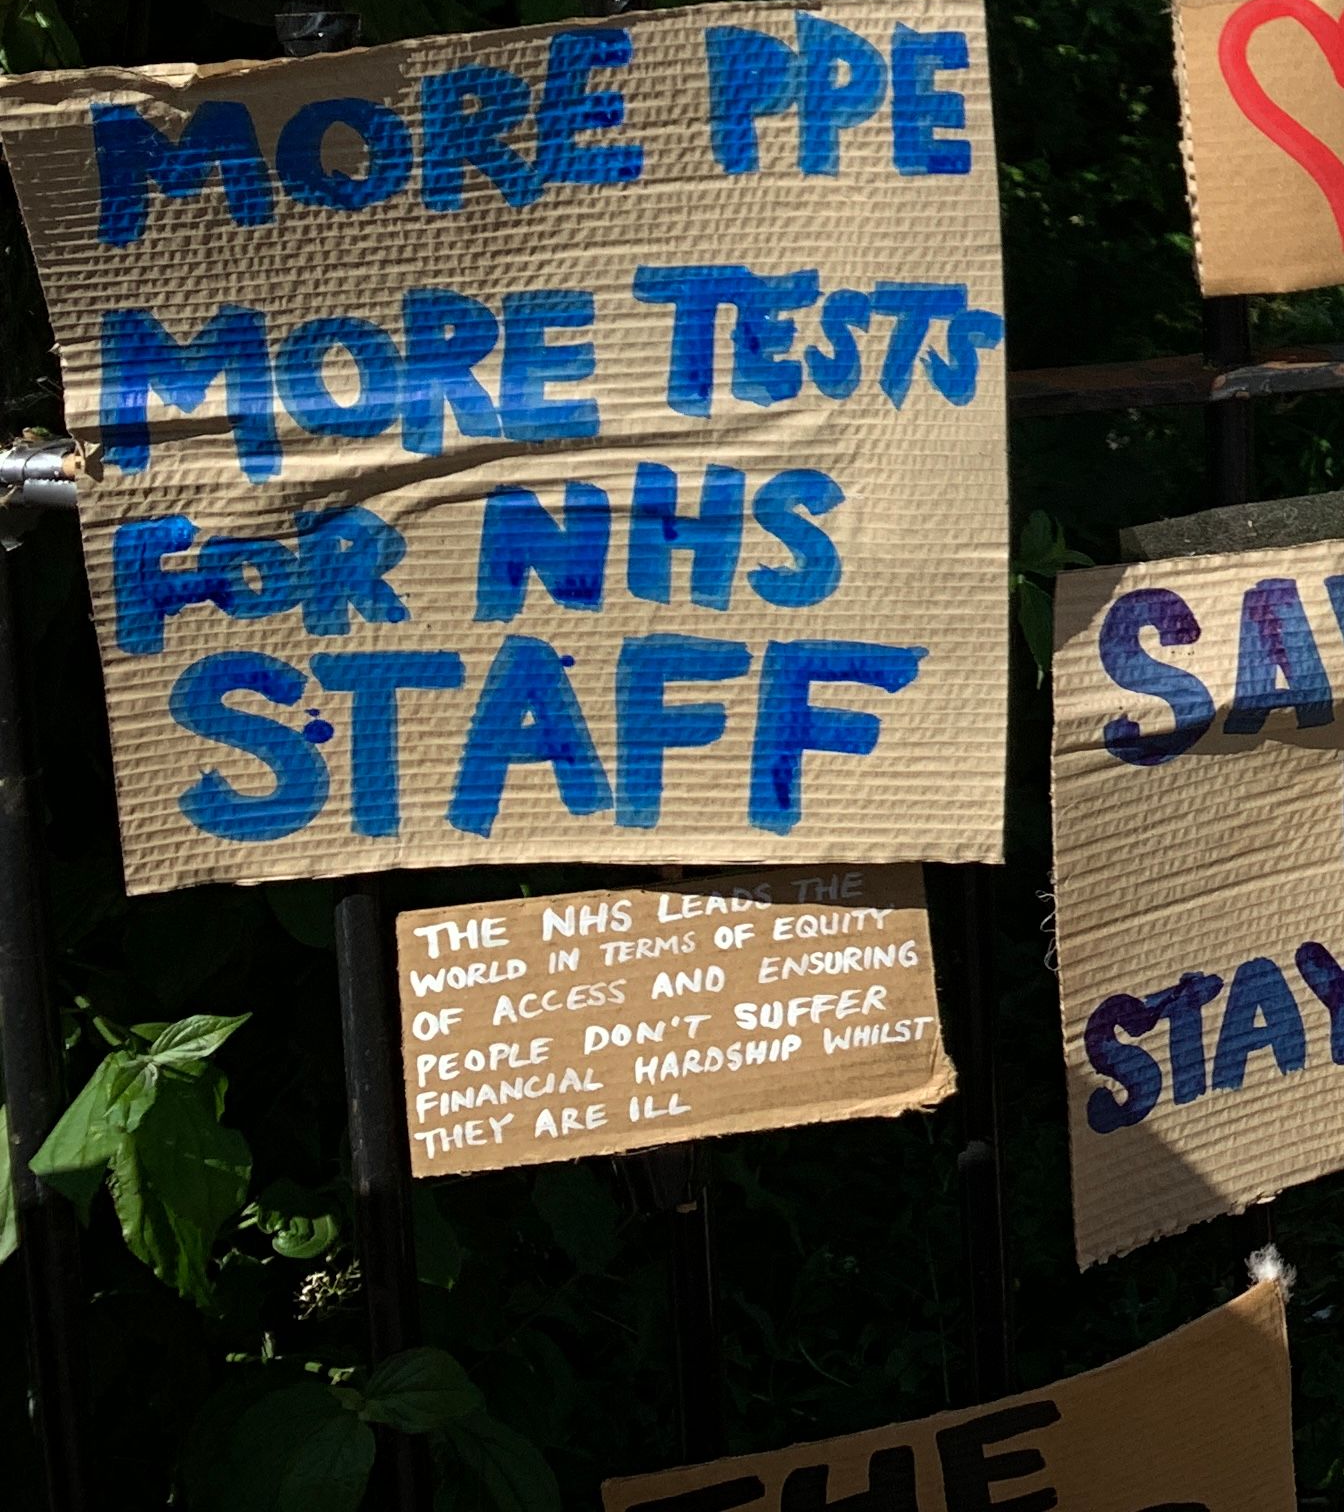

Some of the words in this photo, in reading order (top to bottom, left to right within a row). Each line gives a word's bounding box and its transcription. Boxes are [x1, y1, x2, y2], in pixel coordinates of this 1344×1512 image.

[88, 27, 645, 249] MORE
[703, 10, 974, 178] PPE
[98, 286, 602, 483] MORE
[631, 263, 1006, 420] TESTS
[474, 460, 845, 625] NHS
[167, 631, 931, 841] STAFF
[409, 958, 529, 999] WORLD
[547, 947, 581, 974] IN
[598, 930, 697, 967] TERMS
[713, 922, 756, 950] OF
[772, 906, 893, 943] EQUITY
[413, 916, 510, 960] THE
[541, 898, 634, 943] NHS
[656, 881, 773, 926] LEADS
[792, 870, 864, 905] THE
[412, 1006, 464, 1042] OF
[491, 978, 627, 1028] ACCESS
[651, 965, 727, 1000] AND
[756, 939, 920, 986] ENSURING
[415, 1036, 554, 1089] PEOPLE
[583, 1012, 713, 1056] DON'T
[734, 984, 889, 1033] SUFFER
[415, 1065, 604, 1125] FINANCIAL
[633, 1033, 802, 1086] HARDSHIP
[822, 1014, 937, 1056] WHILST
[412, 1112, 516, 1161] THEY
[532, 1100, 610, 1140] ARE
[628, 1091, 693, 1124] ILL
